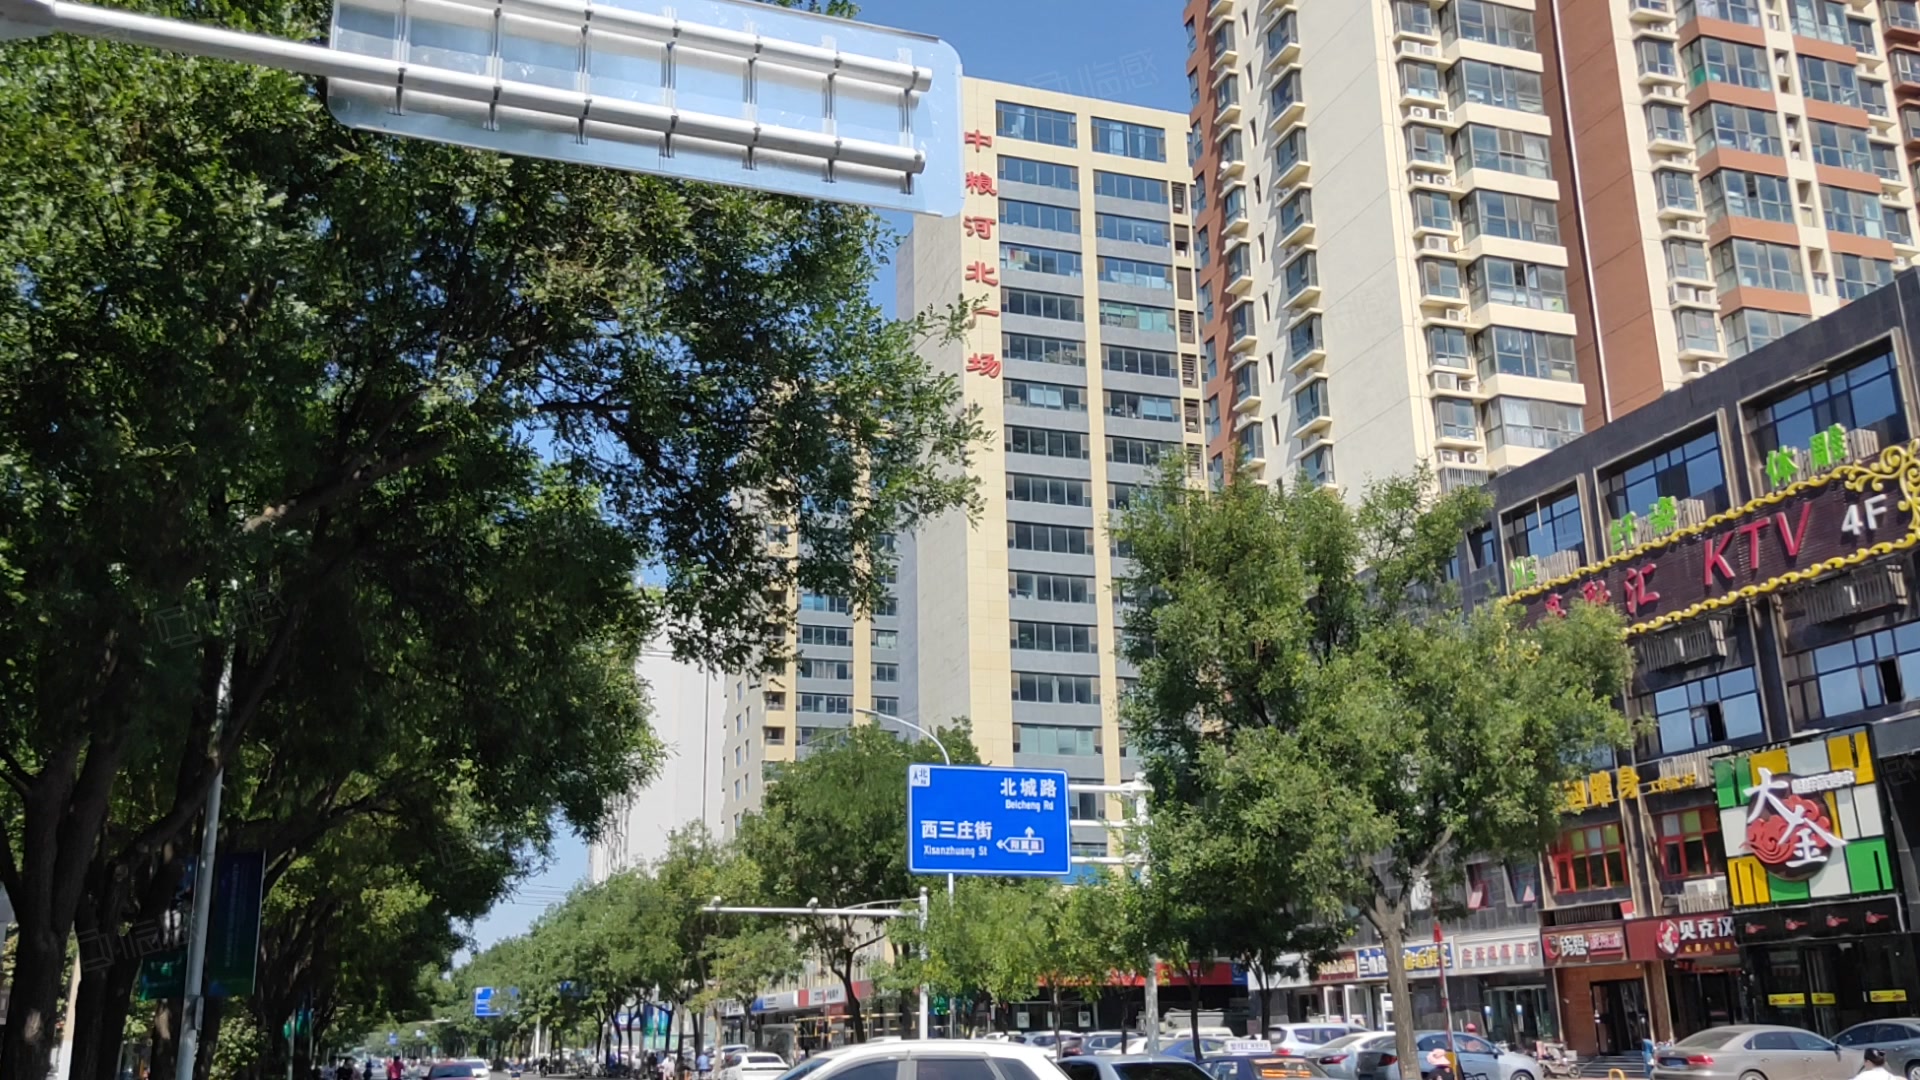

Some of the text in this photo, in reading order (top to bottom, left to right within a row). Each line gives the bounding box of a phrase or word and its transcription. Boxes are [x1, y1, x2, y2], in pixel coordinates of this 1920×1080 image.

[1703, 501, 1812, 586] KTV
[1841, 493, 1888, 535] 4F
[1000, 777, 1057, 798] 北城路
[1005, 799, 1054, 813] Beicheng Rd
[920, 820, 992, 840] 西三庄街
[923, 845, 988, 858] Xisanzhuang St
